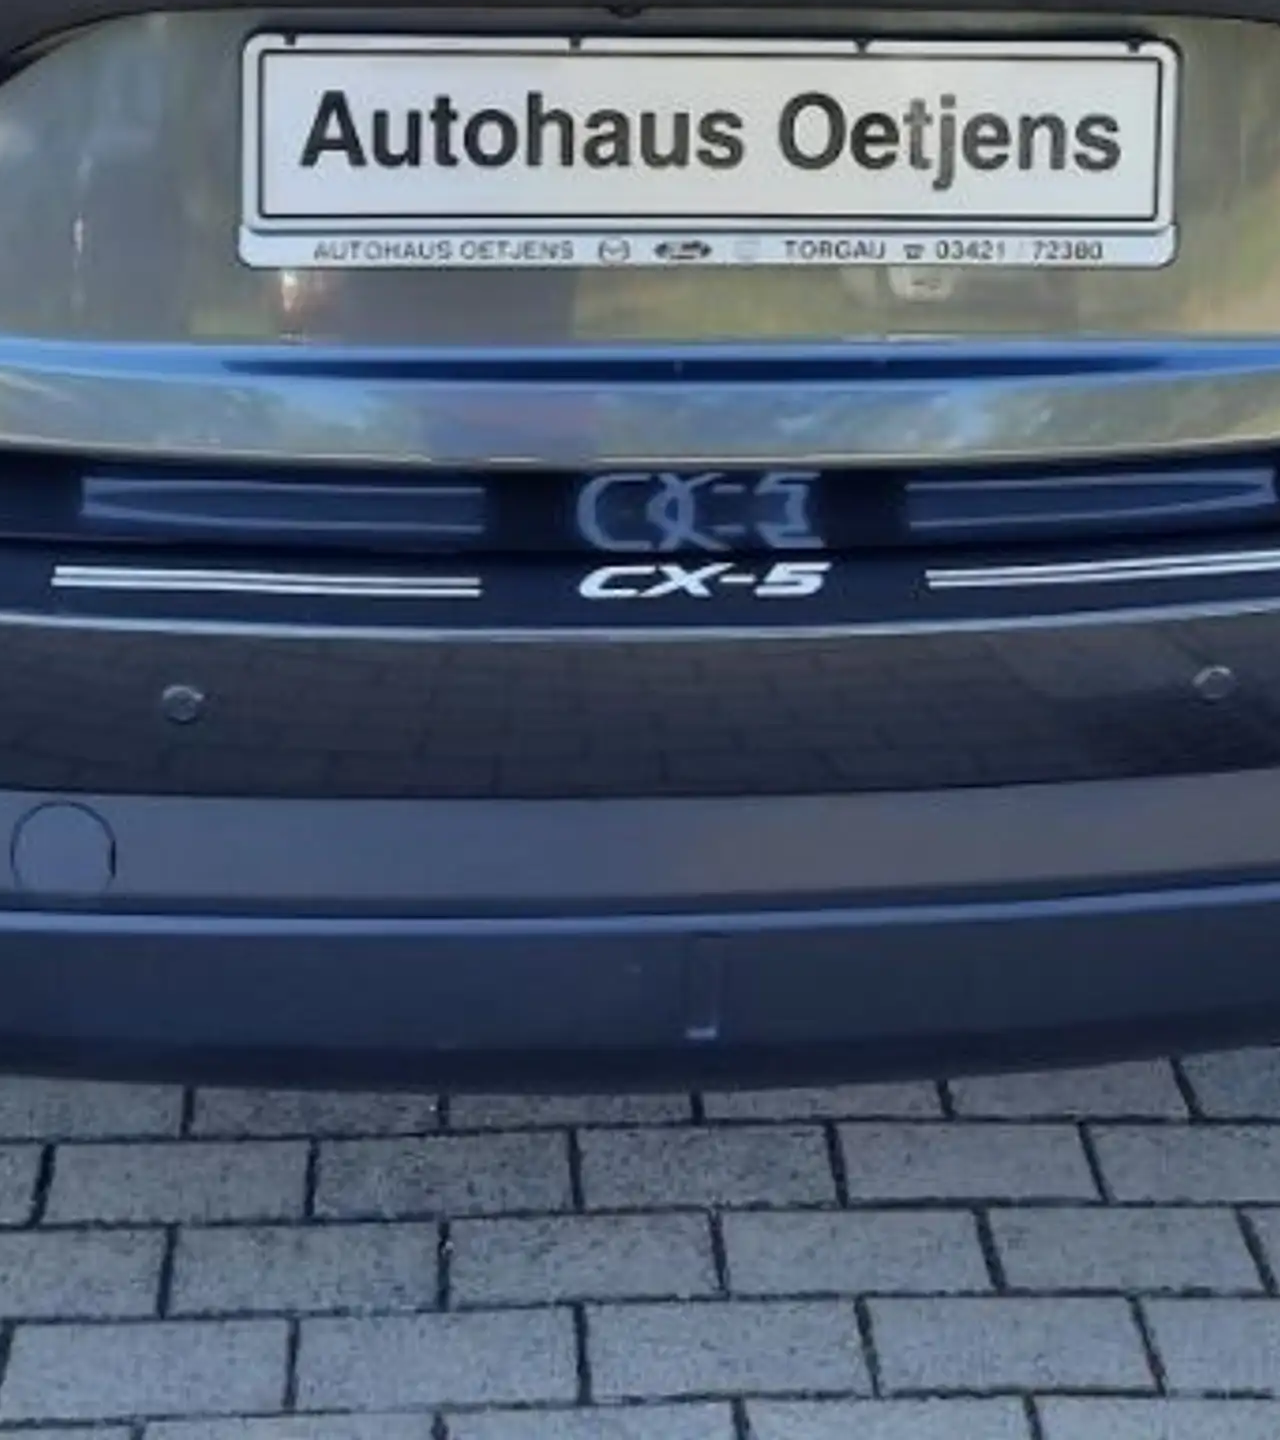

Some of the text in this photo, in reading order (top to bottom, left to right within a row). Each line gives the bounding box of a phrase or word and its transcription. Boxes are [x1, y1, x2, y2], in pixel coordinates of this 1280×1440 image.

[299, 90, 1122, 191] Autohaus Oetjens
[313, 240, 454, 261] AUTOHAUS
[459, 240, 575, 261] OETJENS
[784, 239, 886, 260] TORGAU
[935, 239, 1006, 260] 03421
[578, 561, 833, 599] CX-5
